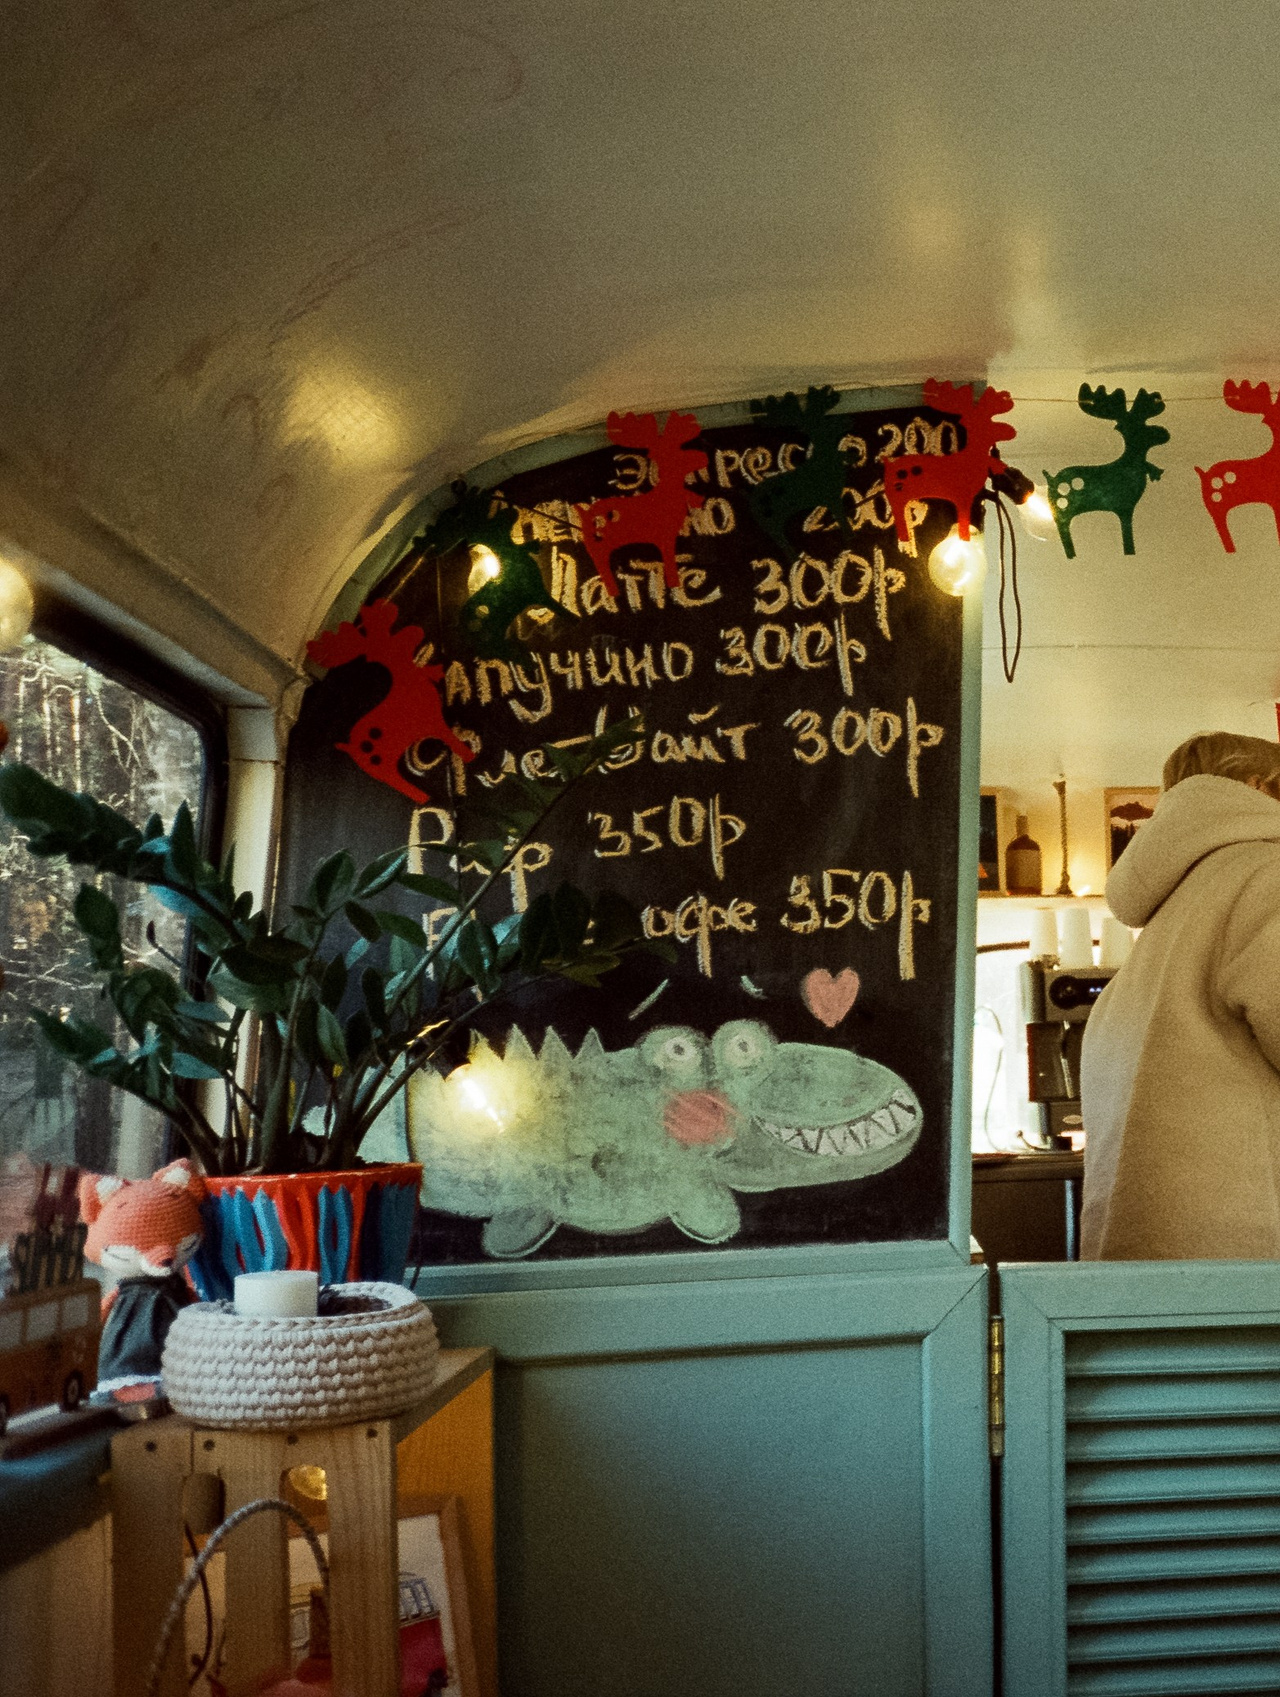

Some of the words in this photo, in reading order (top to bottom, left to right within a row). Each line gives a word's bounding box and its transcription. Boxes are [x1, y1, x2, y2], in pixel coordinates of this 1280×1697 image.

[751, 547, 906, 641] 300р
[412, 640, 693, 722] апучино
[715, 611, 868, 697] 300р
[783, 697, 945, 797] 300р
[586, 792, 746, 880] 350р
[640, 893, 758, 979] офе
[781, 869, 932, 981] 350р
